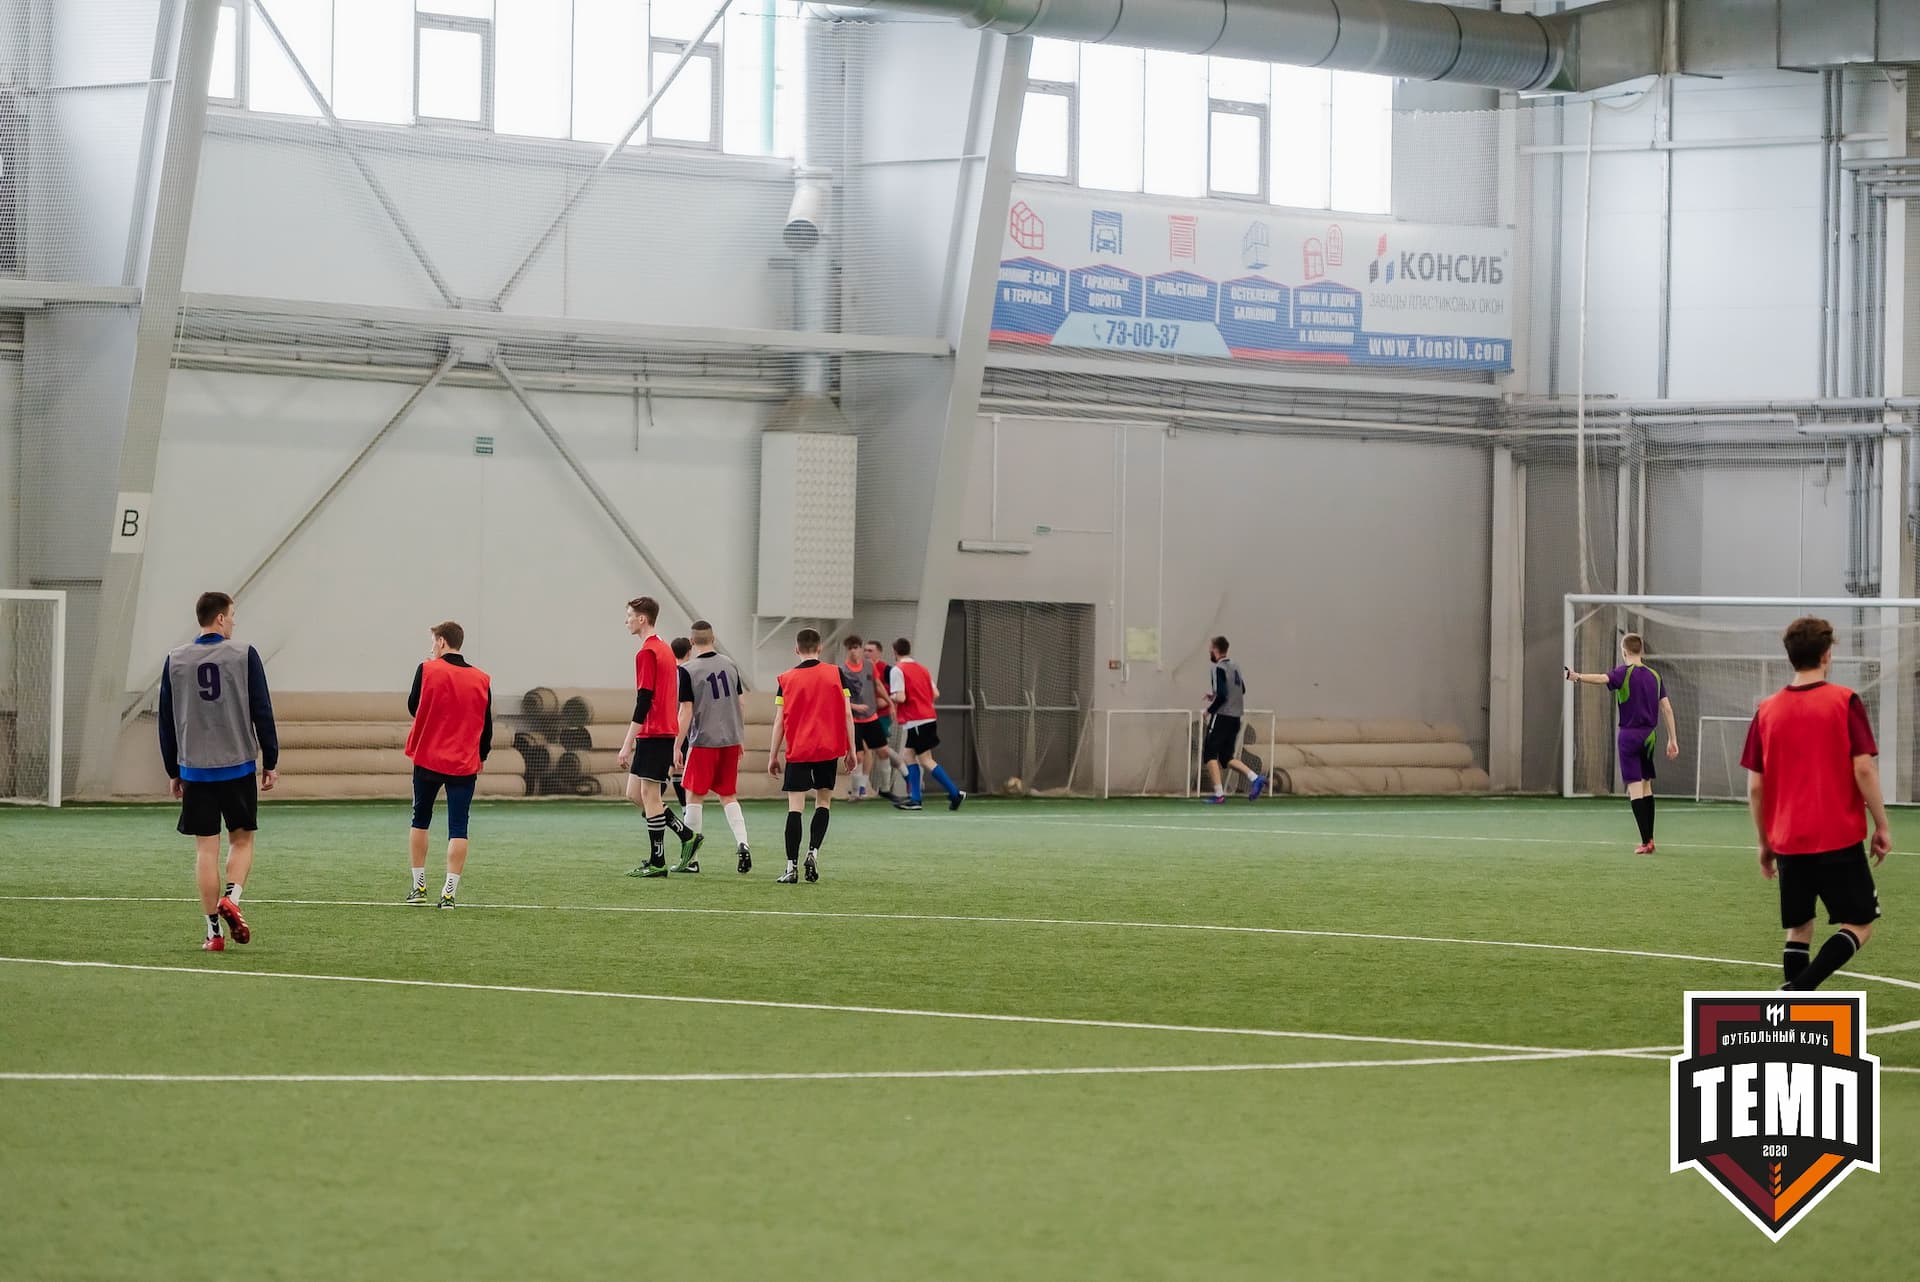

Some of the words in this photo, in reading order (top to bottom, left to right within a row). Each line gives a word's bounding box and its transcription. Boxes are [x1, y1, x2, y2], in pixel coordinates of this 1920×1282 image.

[1400, 250, 1504, 285] КОНСИБ
[1083, 274, 1130, 292] ГАРАЖНЫЕ
[1011, 288, 1052, 305] ТЕРРАСЫ
[1088, 292, 1123, 309] ВОРОТА
[1369, 293, 1408, 312] ЗАВОДЫ
[1408, 294, 1478, 314] ПЛАСТИКОВЫХ
[1479, 297, 1504, 315] ОКОН
[1105, 319, 1181, 349] 73-00-37
[1369, 336, 1505, 361] www.konsib.com
[196, 662, 222, 702] 9
[706, 670, 731, 700] 11
